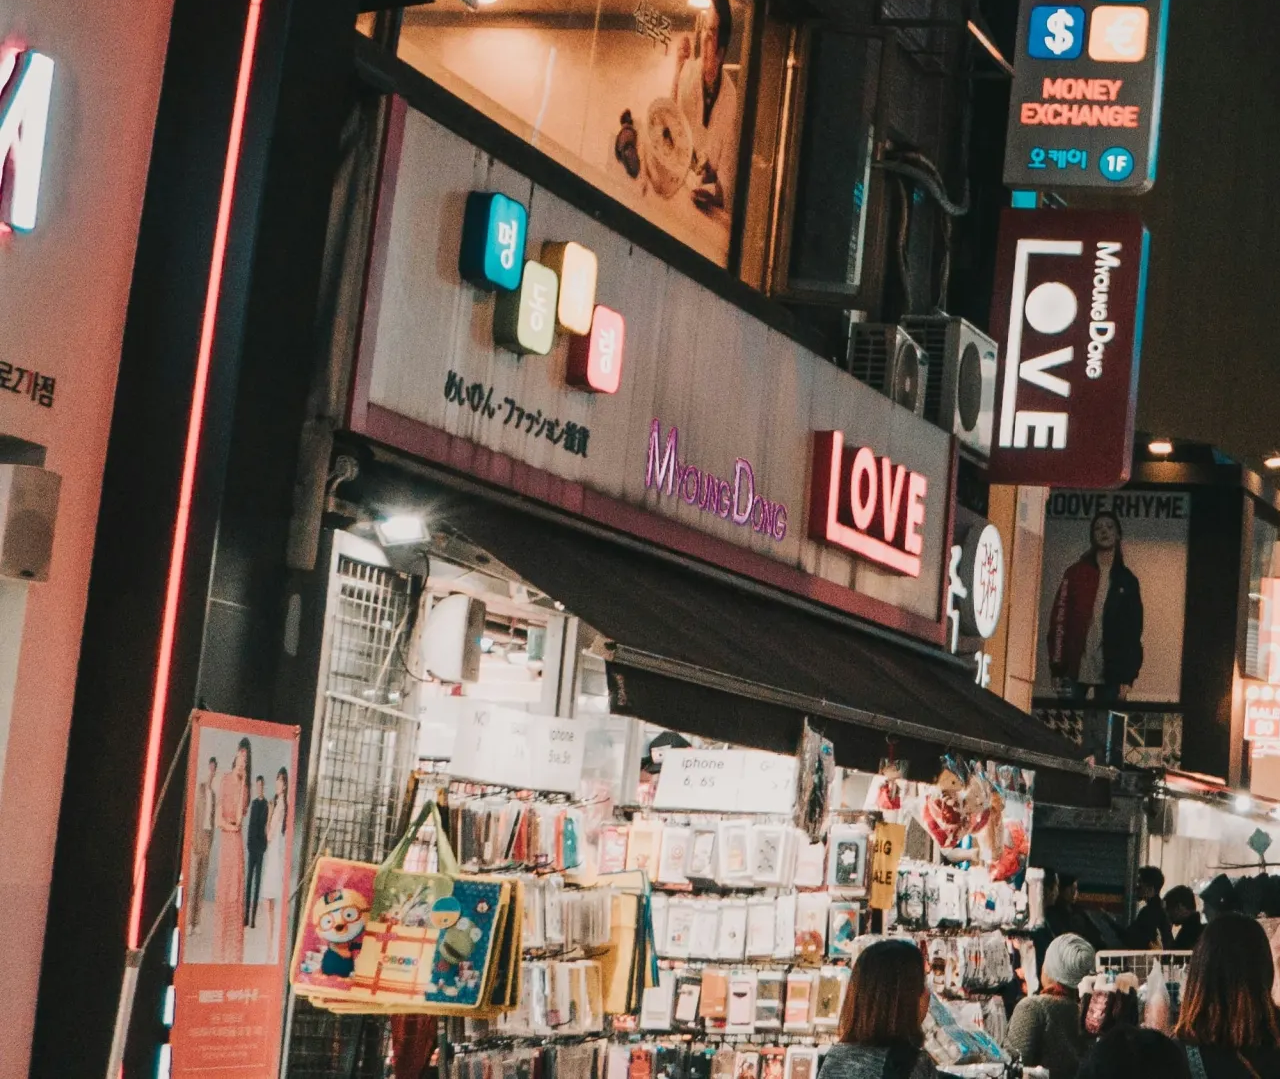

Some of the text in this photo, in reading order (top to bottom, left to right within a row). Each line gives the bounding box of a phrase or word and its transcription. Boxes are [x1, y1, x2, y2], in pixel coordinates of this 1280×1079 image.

[1044, 8, 1074, 55] $
[1042, 78, 1123, 101] MONEY
[1020, 103, 1140, 128] EXCHANGE
[1027, 147, 1128, 172] 오케이 1F
[999, 239, 1083, 449] LOVE
[826, 430, 927, 578] LOVE
[1112, 495, 1184, 519] RHYME
